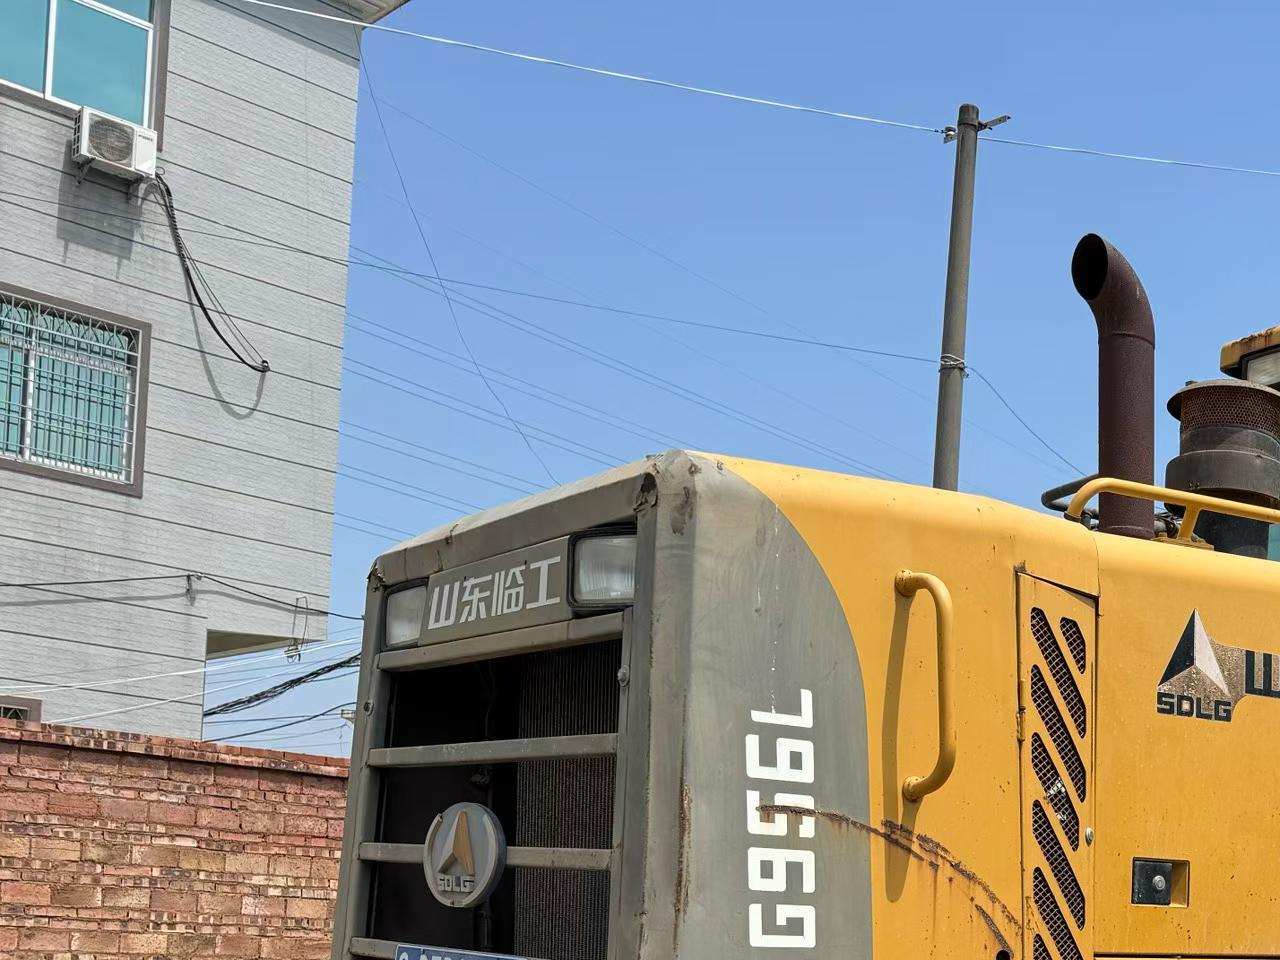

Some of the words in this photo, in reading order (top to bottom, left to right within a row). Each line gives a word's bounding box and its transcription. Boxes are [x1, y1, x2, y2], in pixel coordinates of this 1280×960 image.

[428, 555, 561, 630] 山东临工
[1156, 691, 1232, 723] SDLG
